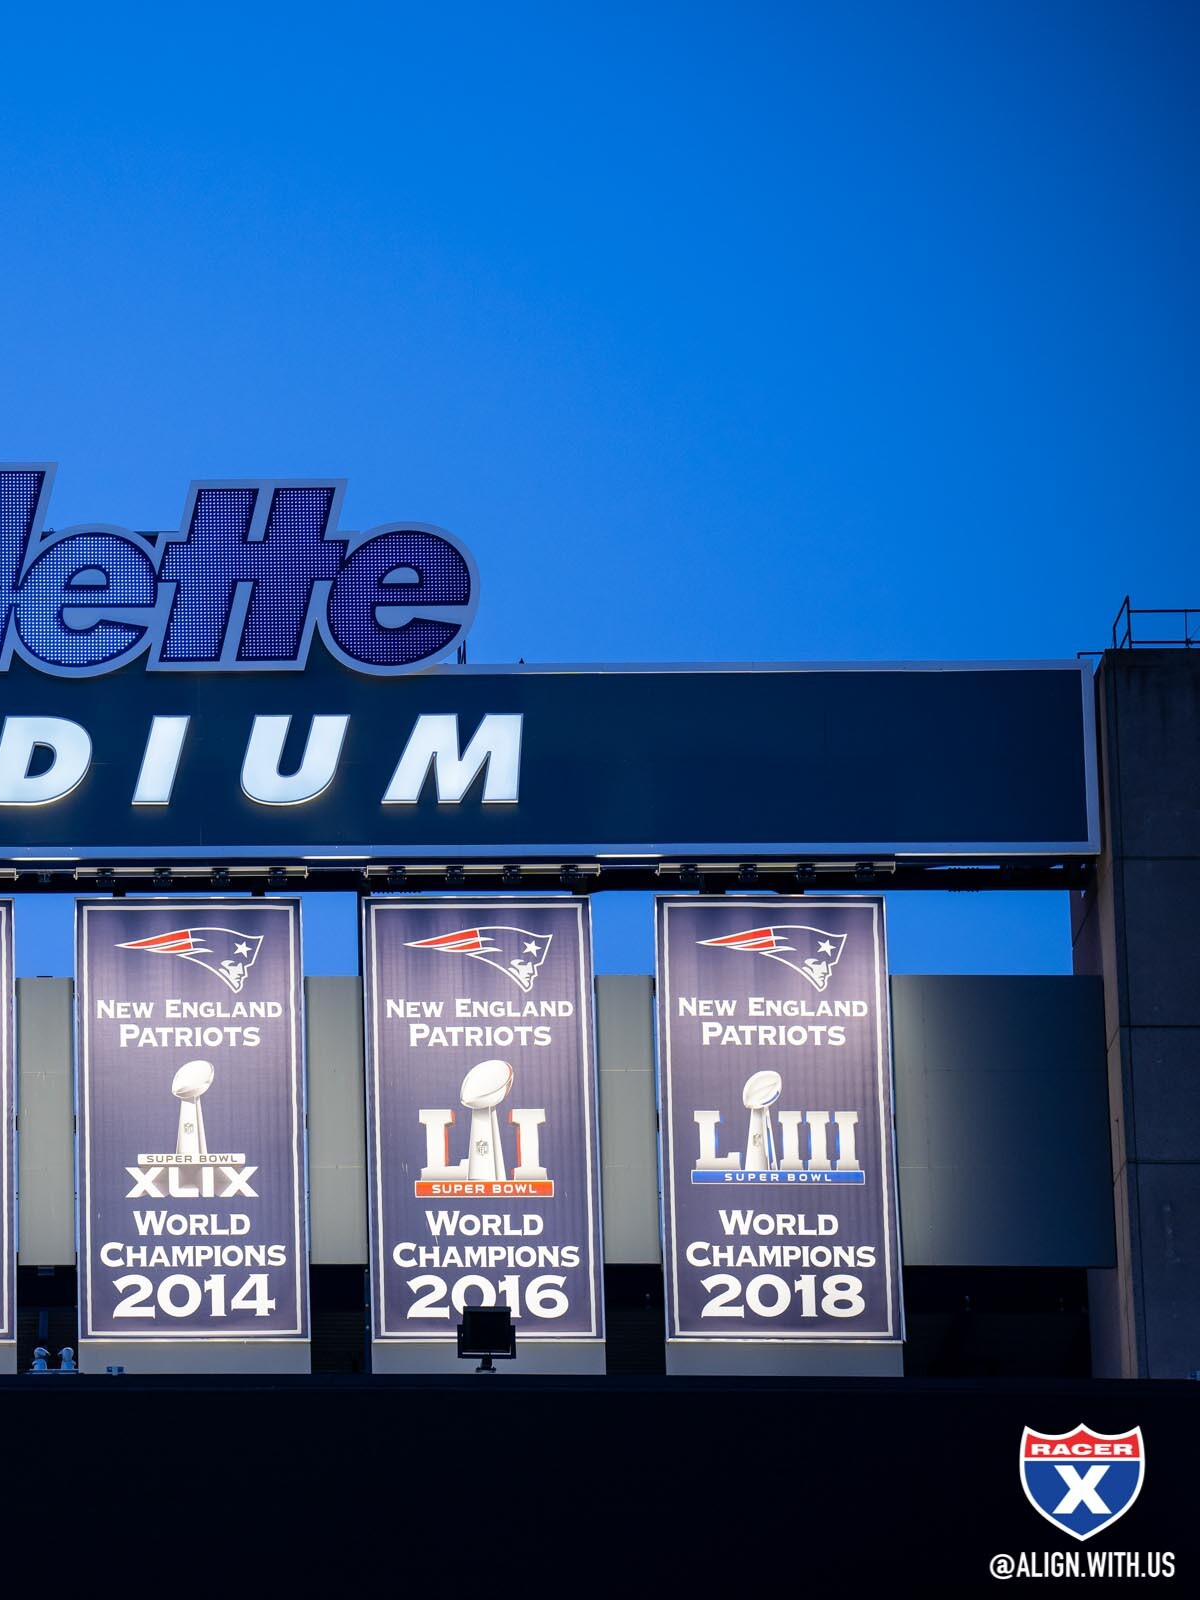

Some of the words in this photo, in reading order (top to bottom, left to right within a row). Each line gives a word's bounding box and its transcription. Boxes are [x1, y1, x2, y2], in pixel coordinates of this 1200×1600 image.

[96, 999, 155, 1019] NEW
[165, 999, 283, 1019] ENGLAND
[386, 998, 445, 1018] NEW
[455, 998, 574, 1018] ENGLAND
[678, 997, 737, 1017] NEW
[748, 997, 868, 1017] ENGLAND
[119, 1023, 261, 1048] PATRIOTS
[409, 1023, 552, 1047] PATRIOTS
[702, 1021, 846, 1046] PATRIOTS
[418, 1108, 548, 1181] LI
[693, 1110, 860, 1171] LIII
[146, 1155, 193, 1163] SUPER
[199, 1155, 238, 1163] BOWL
[125, 1166, 259, 1198] XLIX
[431, 1184, 485, 1194] SUPER
[492, 1184, 537, 1194] BOWL
[724, 1173, 780, 1182] SUPER
[787, 1173, 832, 1182] BOWL
[133, 1210, 251, 1236] WORLD
[425, 1210, 544, 1236] WORLD
[718, 1209, 839, 1236] WORLD
[100, 1241, 287, 1268] CHAMPIONS
[392, 1242, 580, 1268] CHAMPIONS
[686, 1241, 876, 1268] CHAMPIONS
[112, 1273, 276, 1318] 2014
[406, 1274, 569, 1319] 2016
[701, 1273, 865, 1318] 2018
